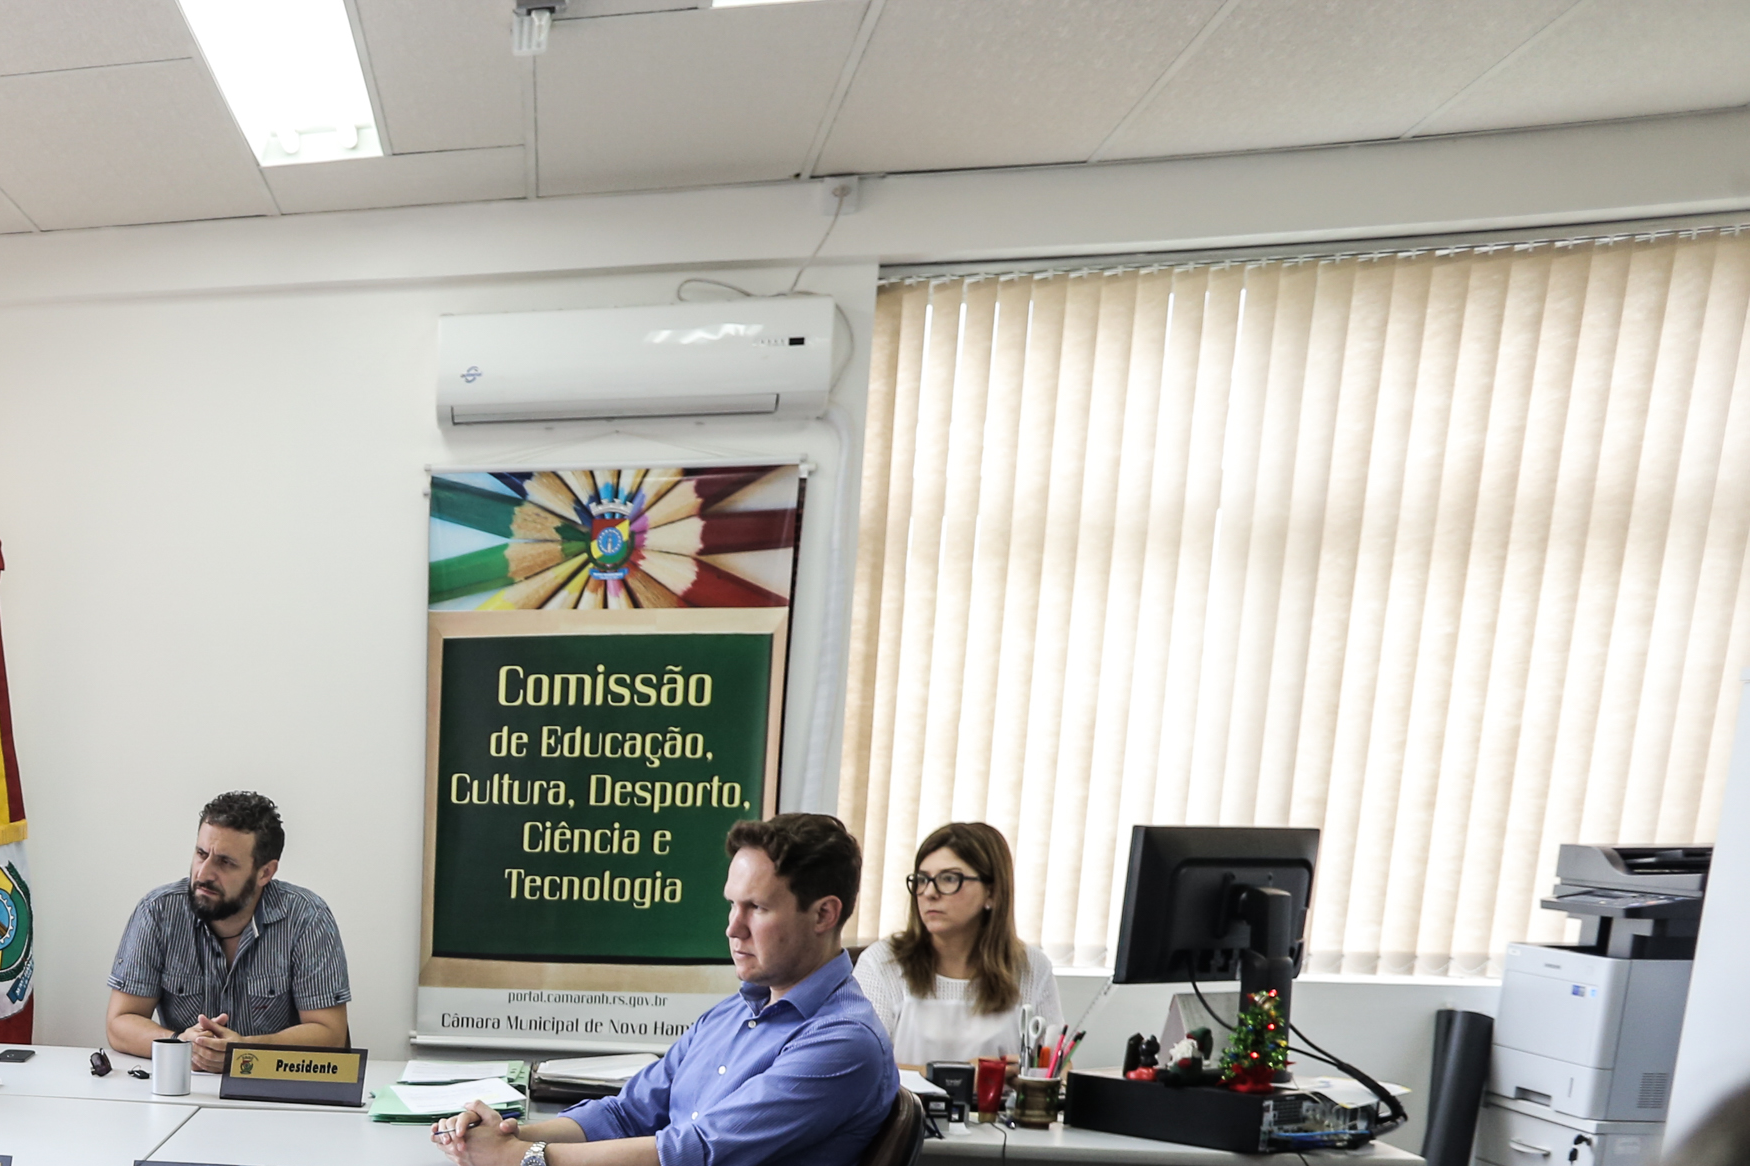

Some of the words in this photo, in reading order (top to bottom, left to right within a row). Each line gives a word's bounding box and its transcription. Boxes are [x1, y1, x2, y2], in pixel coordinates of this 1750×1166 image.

[497, 663, 713, 707] Comissão
[489, 725, 529, 758] de
[540, 725, 714, 768] Educação,
[450, 772, 576, 809] Cultura,
[588, 774, 751, 813] Desporto,
[522, 820, 641, 855] Ciência
[652, 829, 673, 855] e
[504, 867, 683, 909] Tecnologia
[507, 990, 669, 1008] portal.camaranh.rs.gov.br
[440, 1012, 501, 1030] Câmara
[505, 1014, 580, 1035] Municipal
[584, 1017, 604, 1034] de
[608, 1018, 648, 1036] Novo
[652, 1020, 695, 1037] Ham
[275, 1059, 339, 1075] Presidente
